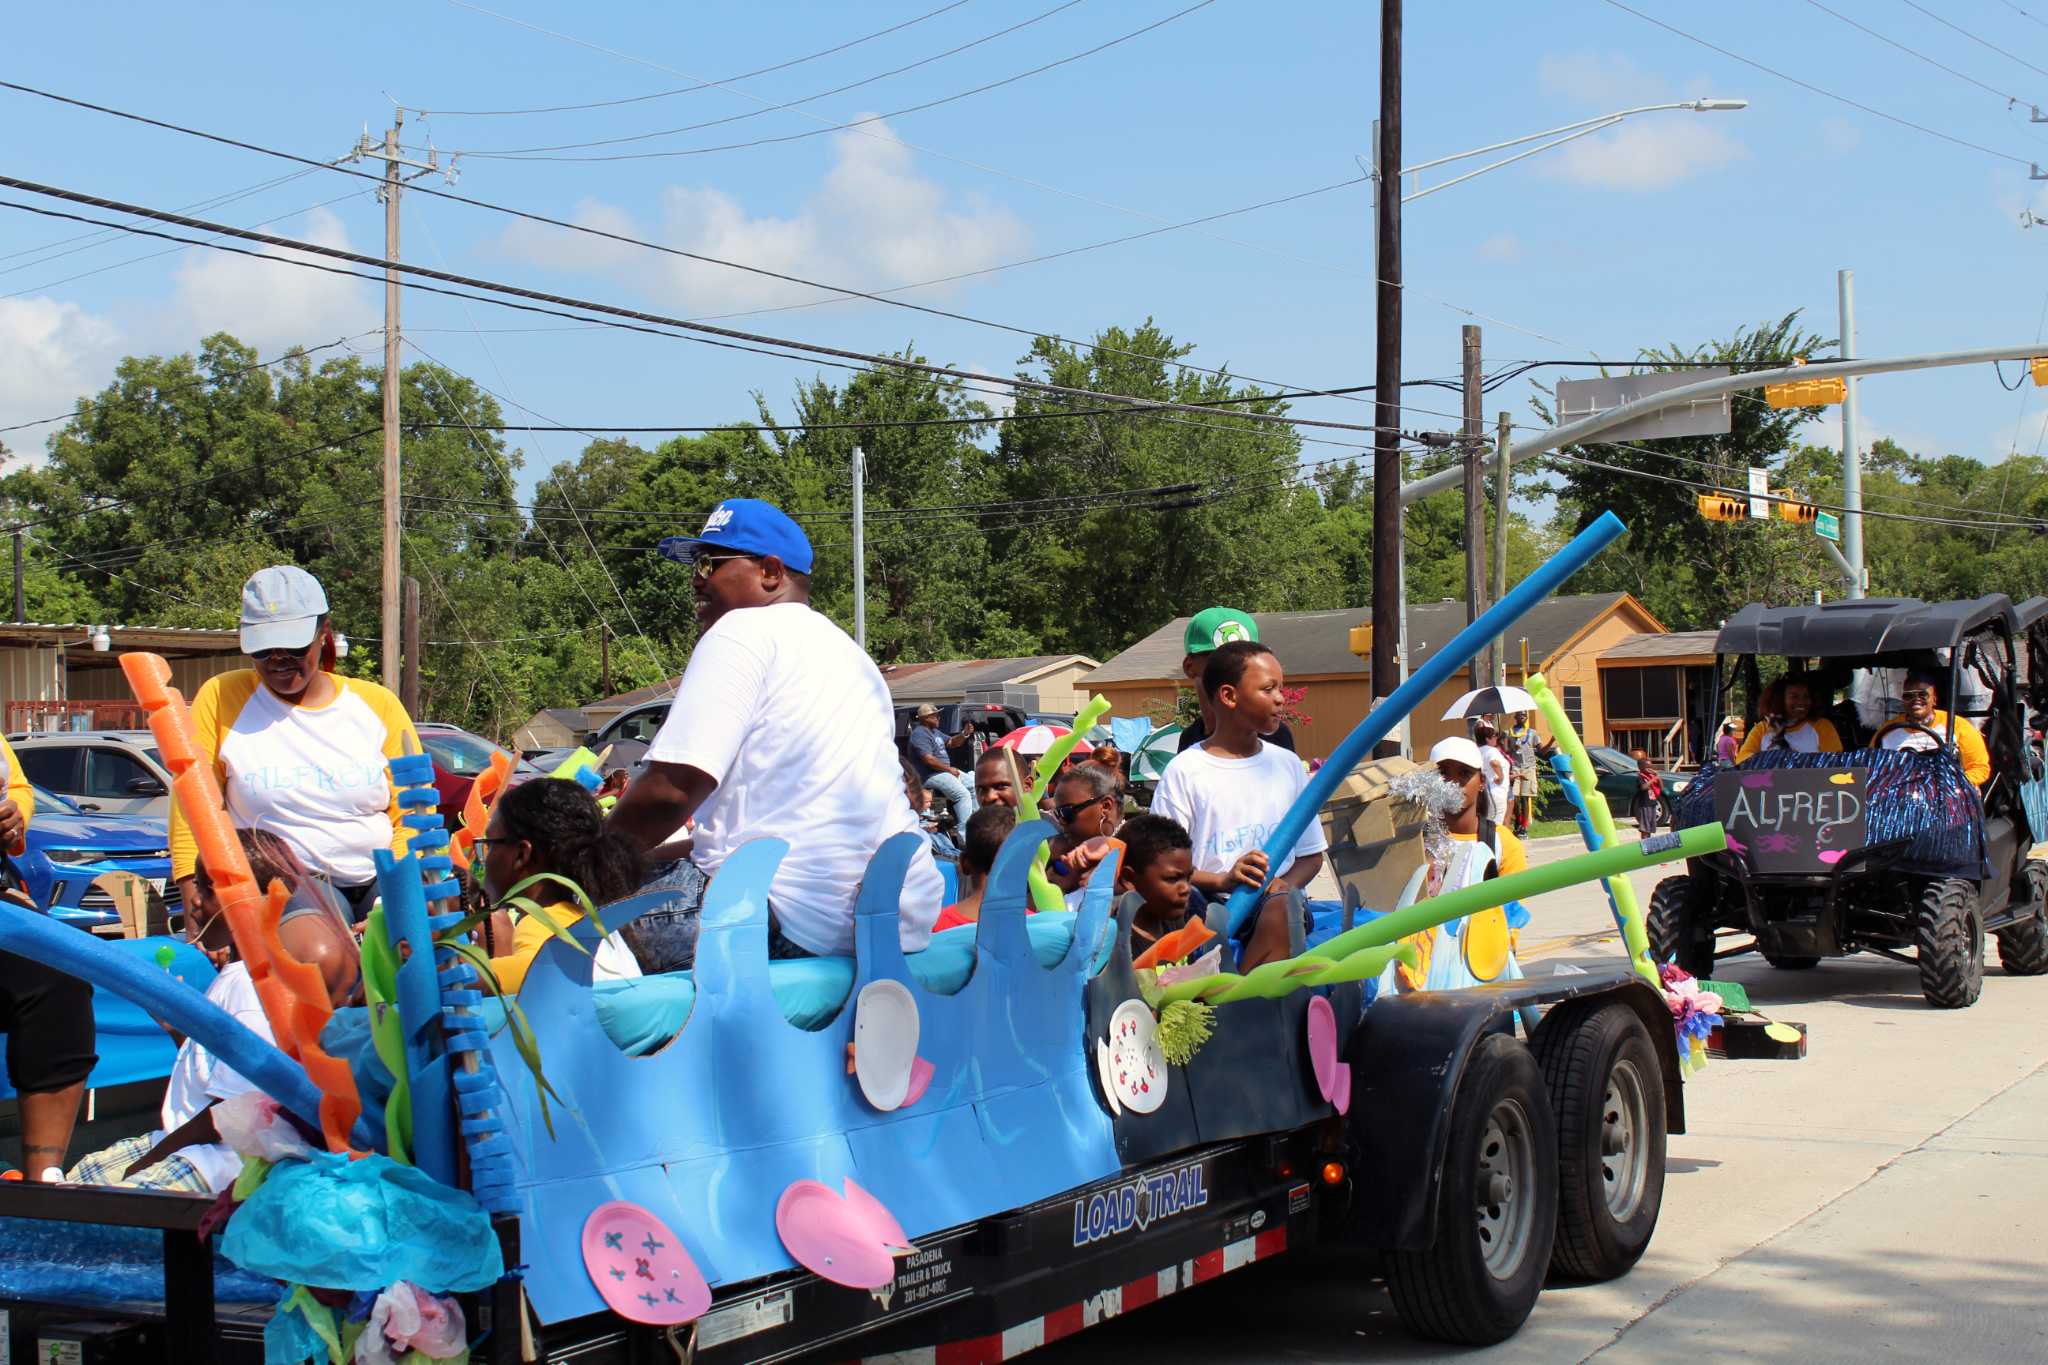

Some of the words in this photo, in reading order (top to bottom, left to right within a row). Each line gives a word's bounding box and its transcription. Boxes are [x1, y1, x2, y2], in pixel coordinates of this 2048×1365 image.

[1725, 786, 1861, 844] ALFRED
[1073, 1185, 1137, 1248] LOAD
[1146, 1163, 1208, 1222] TRAIL
[898, 1270, 924, 1288] TRAILER
[931, 1261, 951, 1277] TRUCK
[906, 1248, 942, 1269] PASADENA
